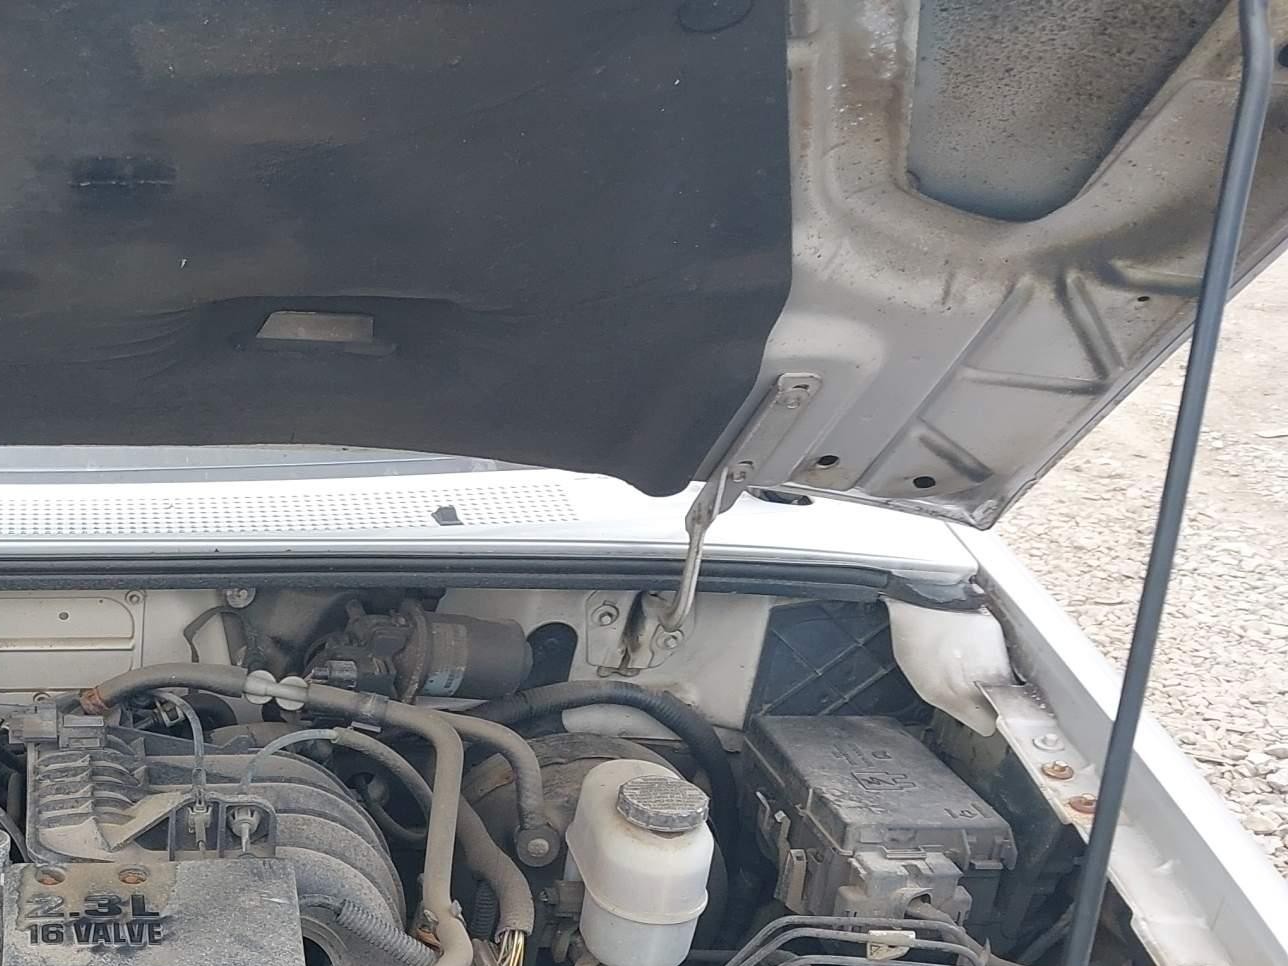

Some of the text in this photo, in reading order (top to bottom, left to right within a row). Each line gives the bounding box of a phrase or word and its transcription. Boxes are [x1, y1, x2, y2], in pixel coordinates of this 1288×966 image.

[25, 894, 160, 918] 2.3L
[29, 922, 163, 945] 16 VALVE
